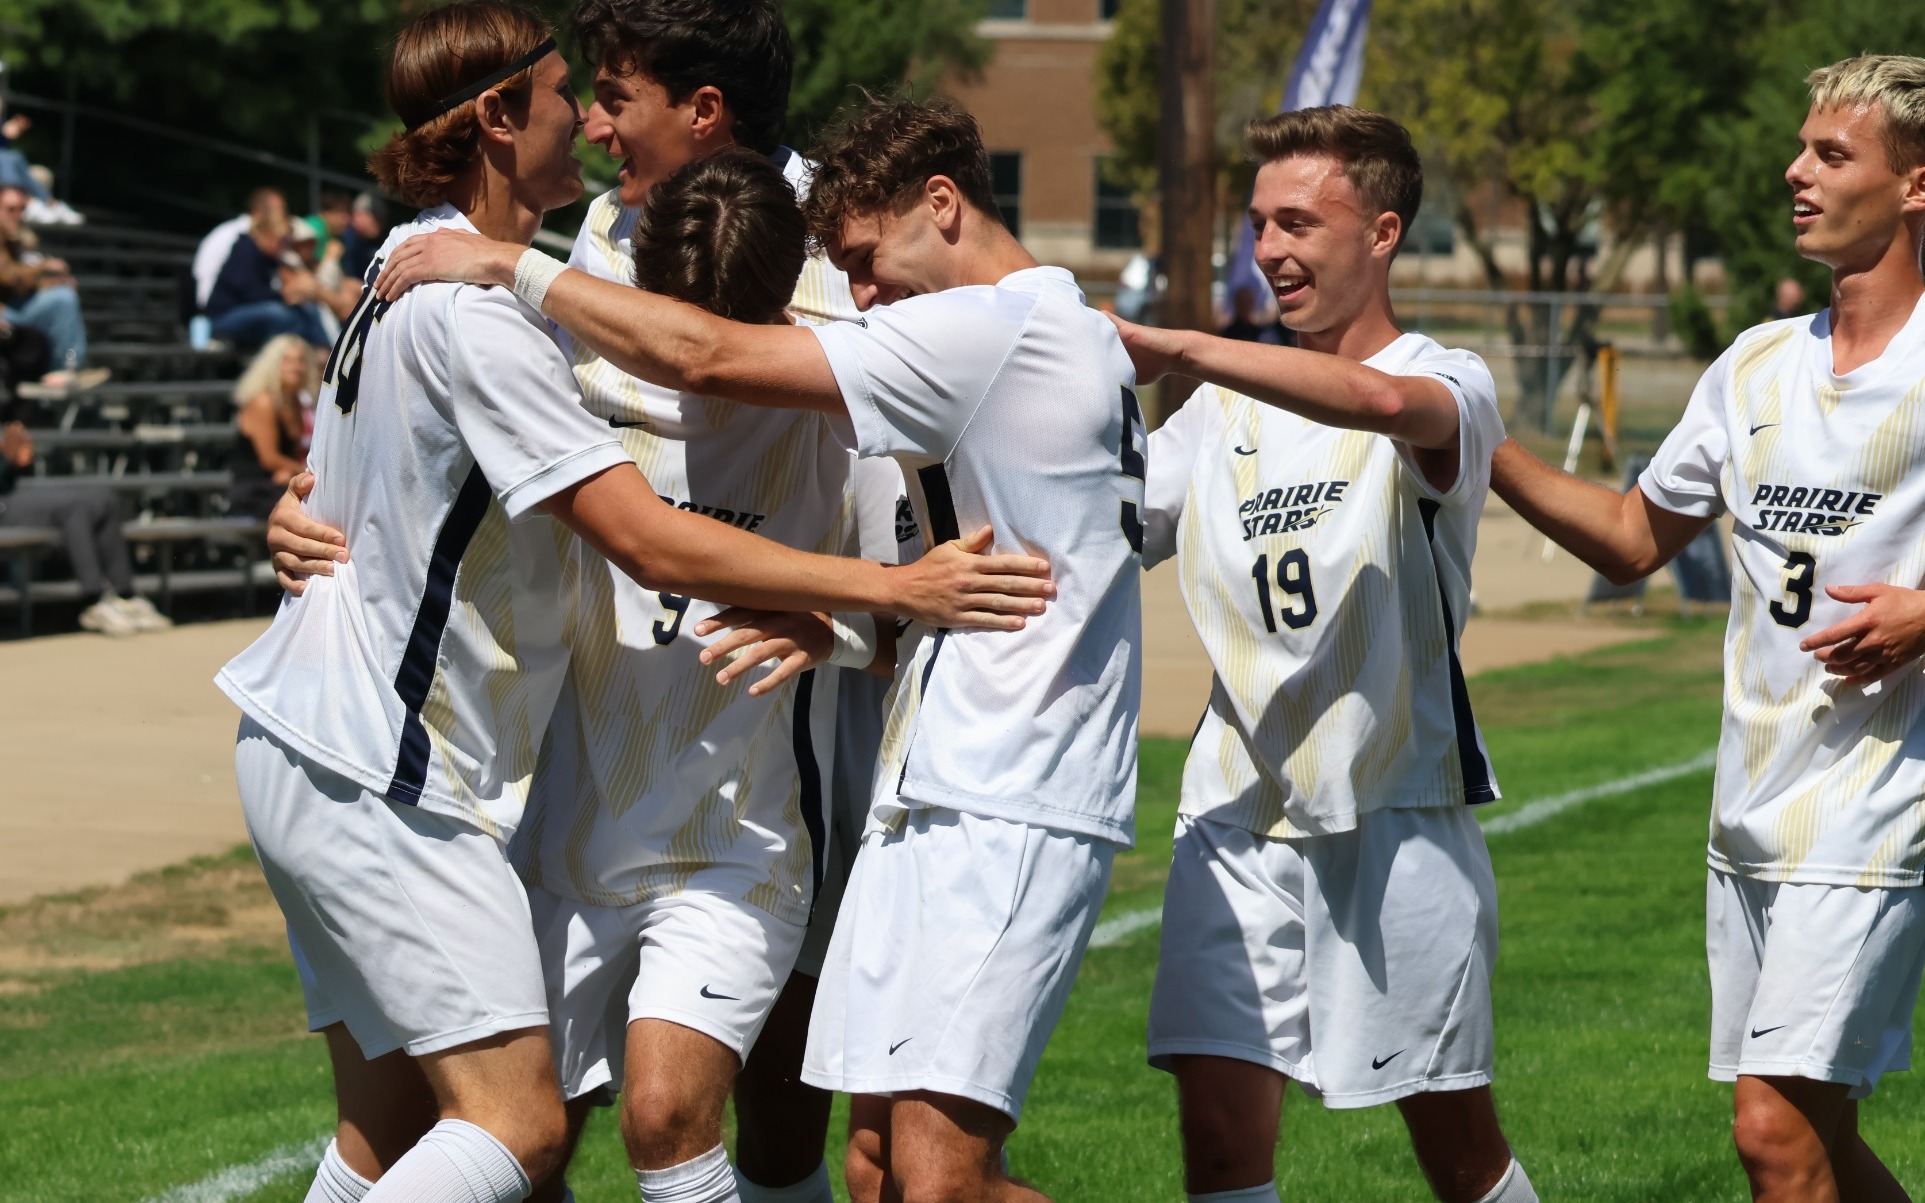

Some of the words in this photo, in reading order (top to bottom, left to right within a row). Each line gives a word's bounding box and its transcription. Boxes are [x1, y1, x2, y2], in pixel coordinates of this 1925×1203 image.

[656, 494, 766, 534] ARIE
[1238, 481, 1350, 518] PRAIRIE
[1750, 483, 1884, 516] PRAIRIE
[1242, 506, 1322, 542] STARS
[1752, 509, 1850, 537] STARS
[1251, 547, 1318, 633] 19
[1768, 550, 1817, 629] 3
